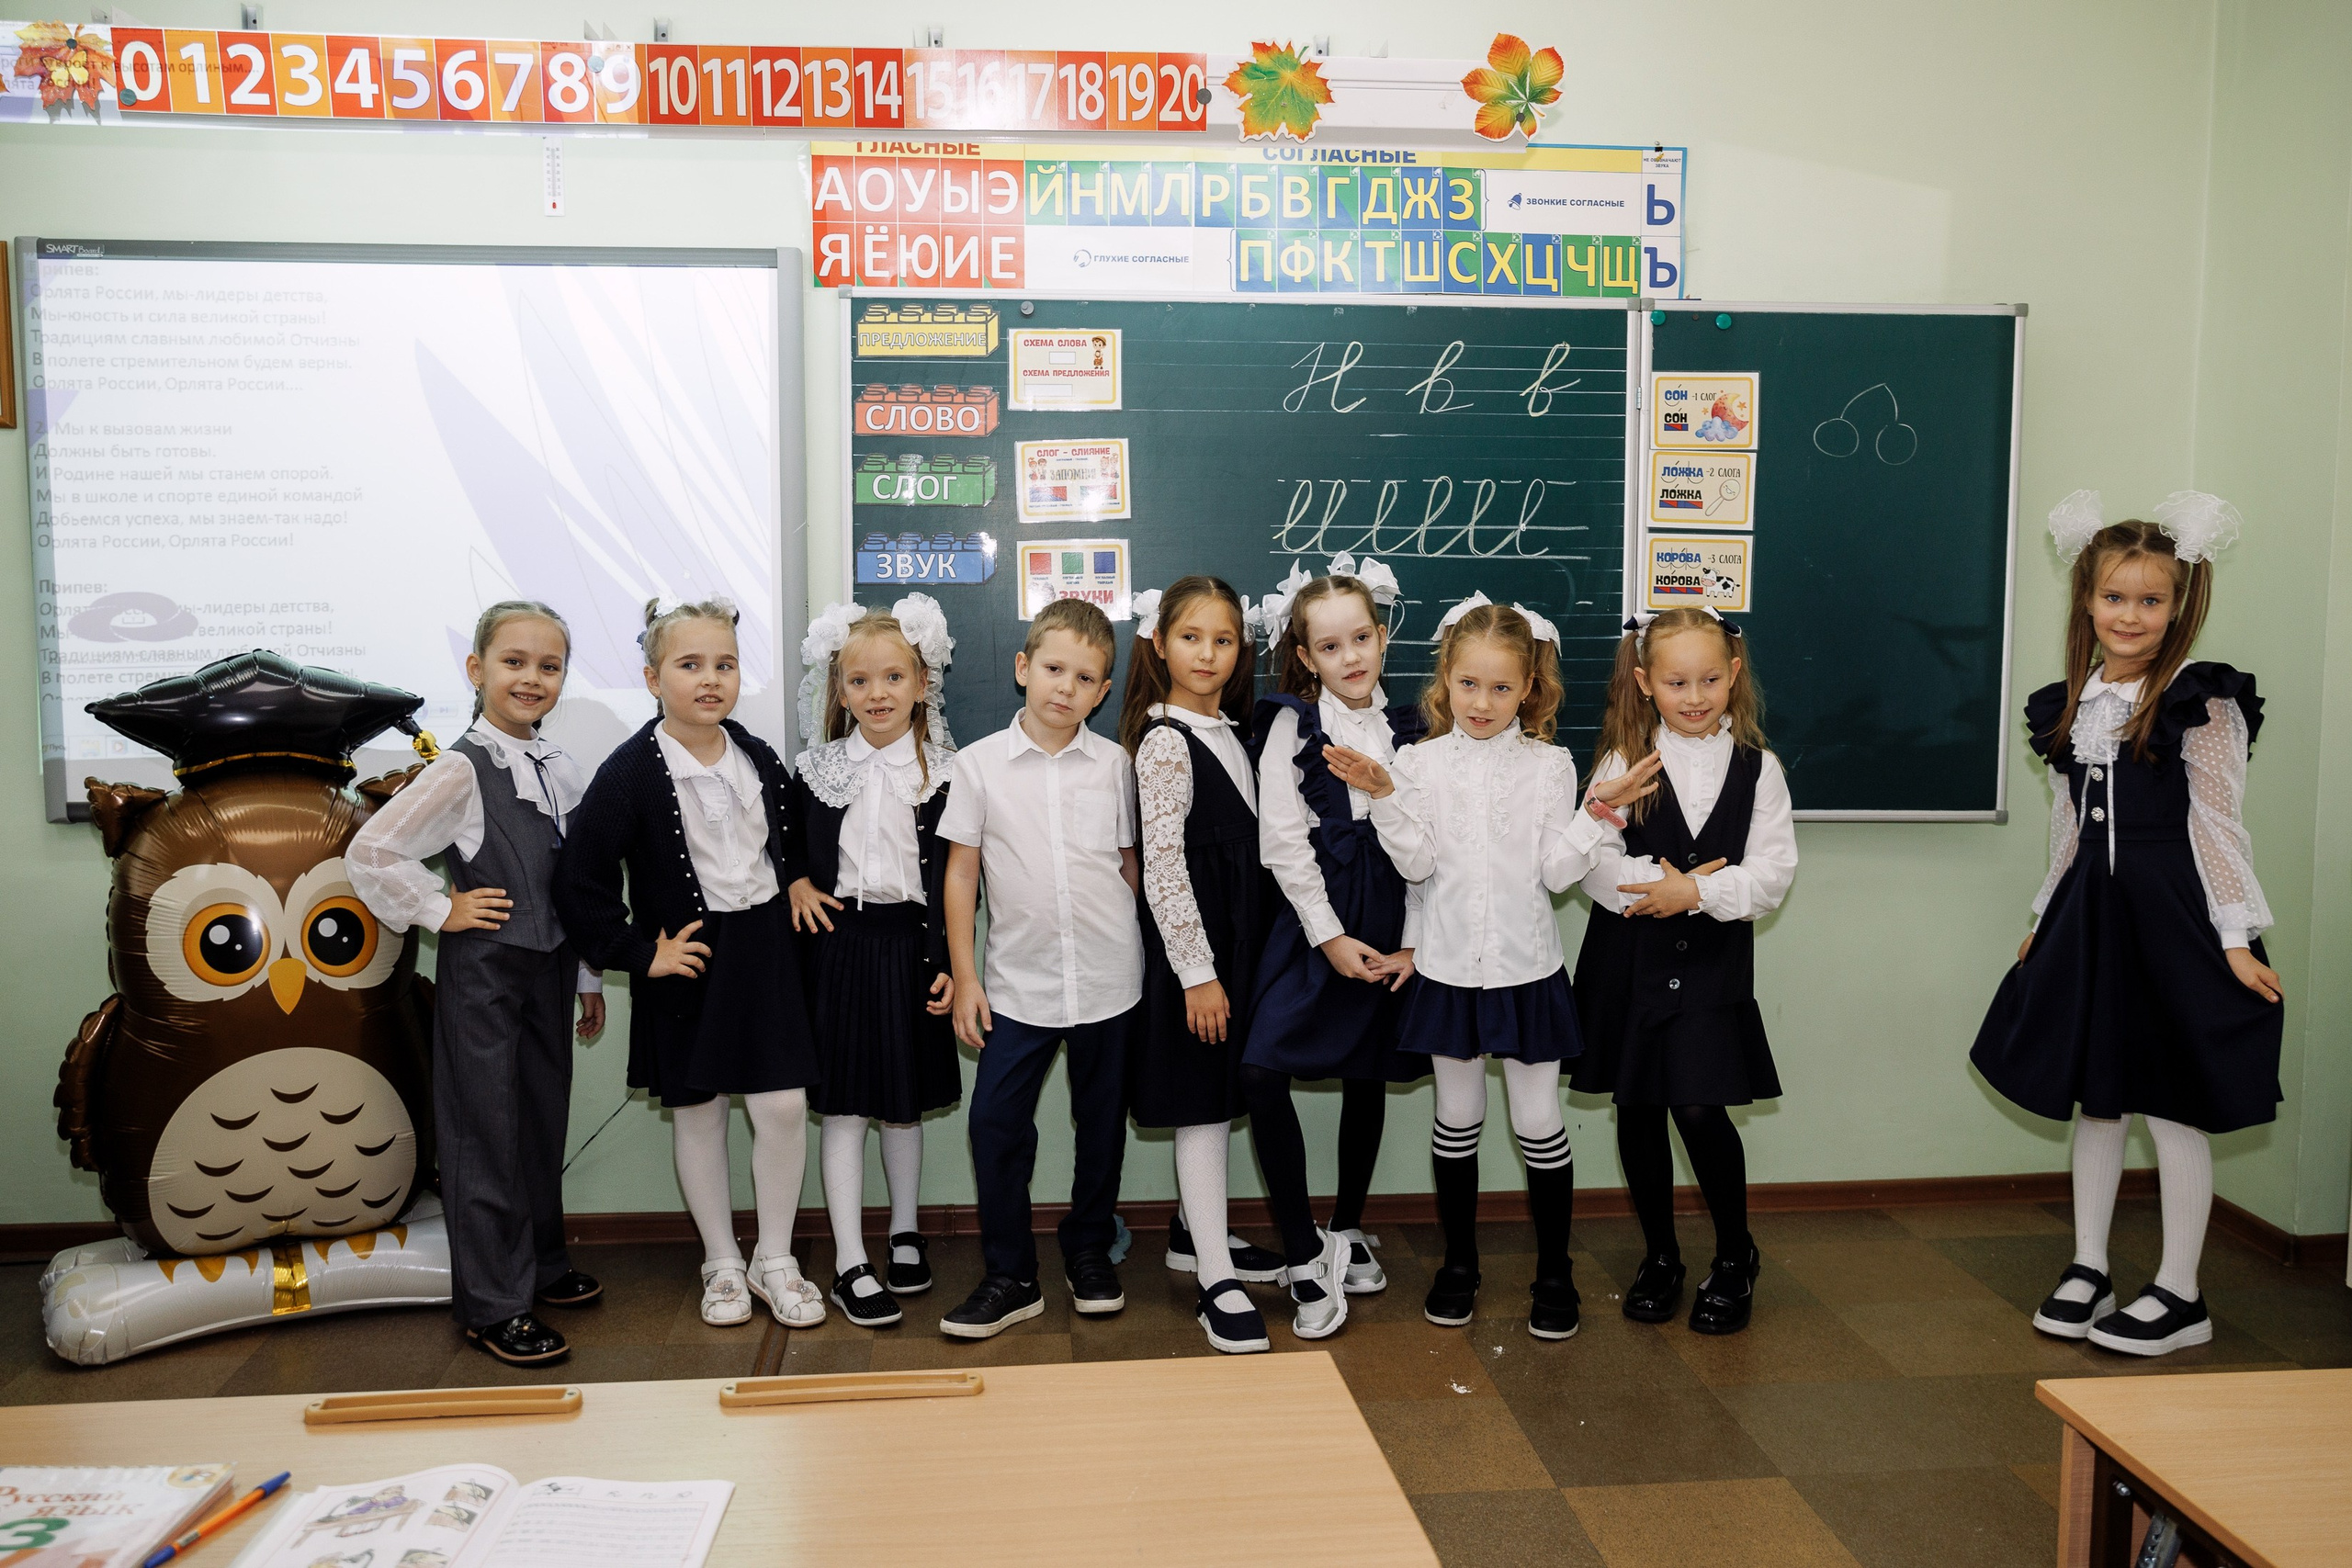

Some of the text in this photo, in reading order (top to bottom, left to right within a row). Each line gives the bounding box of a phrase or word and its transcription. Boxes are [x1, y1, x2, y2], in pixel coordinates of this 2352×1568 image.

[114, 62, 175, 73] высотам
[120, 41, 1205, 122] 0 1 2 3 4 5 6 7 8 9 10 11 12 13 14 15 16 17 18 19 20
[1526, 197, 1625, 208] ЗВОНКИЕ СОГЛАСНЫЕ
[1646, 184, 1676, 225] Ь
[46, 243, 78, 254] SMART
[1093, 254, 1190, 264] ГЛУХИЕ СОГЛАСНЫЕ
[1644, 247, 1678, 288] Ъ
[859, 332, 988, 350] ПРЕДЛОЖЕНИЕ
[1023, 338, 1087, 347] СХЕМА СЛОВА
[1023, 369, 1110, 378] СХЕМА ПРЕДЛОЖЕНИЯ
[1701, 392, 1716, 401] СЛОГ
[865, 405, 980, 432] СЛОВО
[54, 422, 232, 436] Мы к вызовам жизни
[33, 443, 217, 459] Должны быть готовы.
[1036, 447, 1111, 457] СЛОГ СЛИЯНИЕ
[35, 465, 334, 482] И Родине нашей мы станем опорой.
[1718, 468, 1741, 478] СЛОГА
[36, 486, 363, 506] Мы в школе и спорте единой командой
[872, 474, 957, 501] СЛОГ
[36, 510, 348, 529] Добьемся успеха, мы знаем-так надо!
[37, 533, 294, 550] Орлята России, Орлята России!
[876, 553, 956, 579] ЗВУК
[1719, 554, 1742, 564] СЛОГА
[39, 579, 108, 596] Припев:
[0, 1517, 70, 1551] 3
